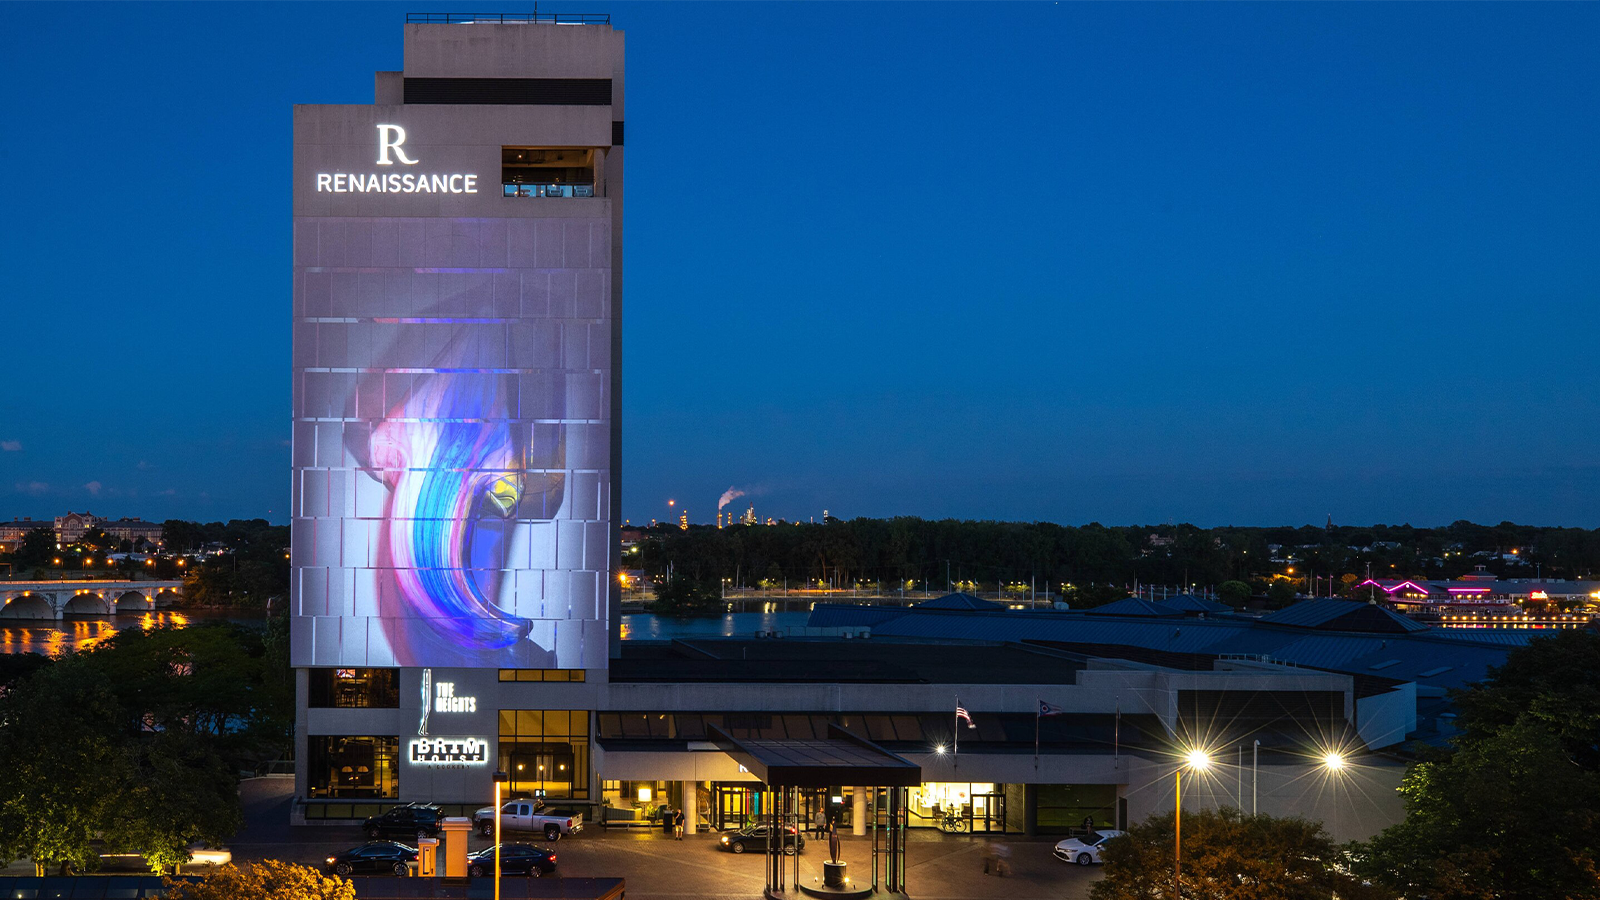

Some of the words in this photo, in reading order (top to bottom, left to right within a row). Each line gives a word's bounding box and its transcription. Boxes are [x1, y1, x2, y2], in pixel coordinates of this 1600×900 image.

[376, 124, 419, 165] R
[317, 174, 478, 193] RENAISSANCE
[436, 682, 454, 697] THE
[436, 697, 476, 712] HEIGHTS
[417, 738, 480, 754] BRIM
[418, 755, 480, 763] HOUSE
